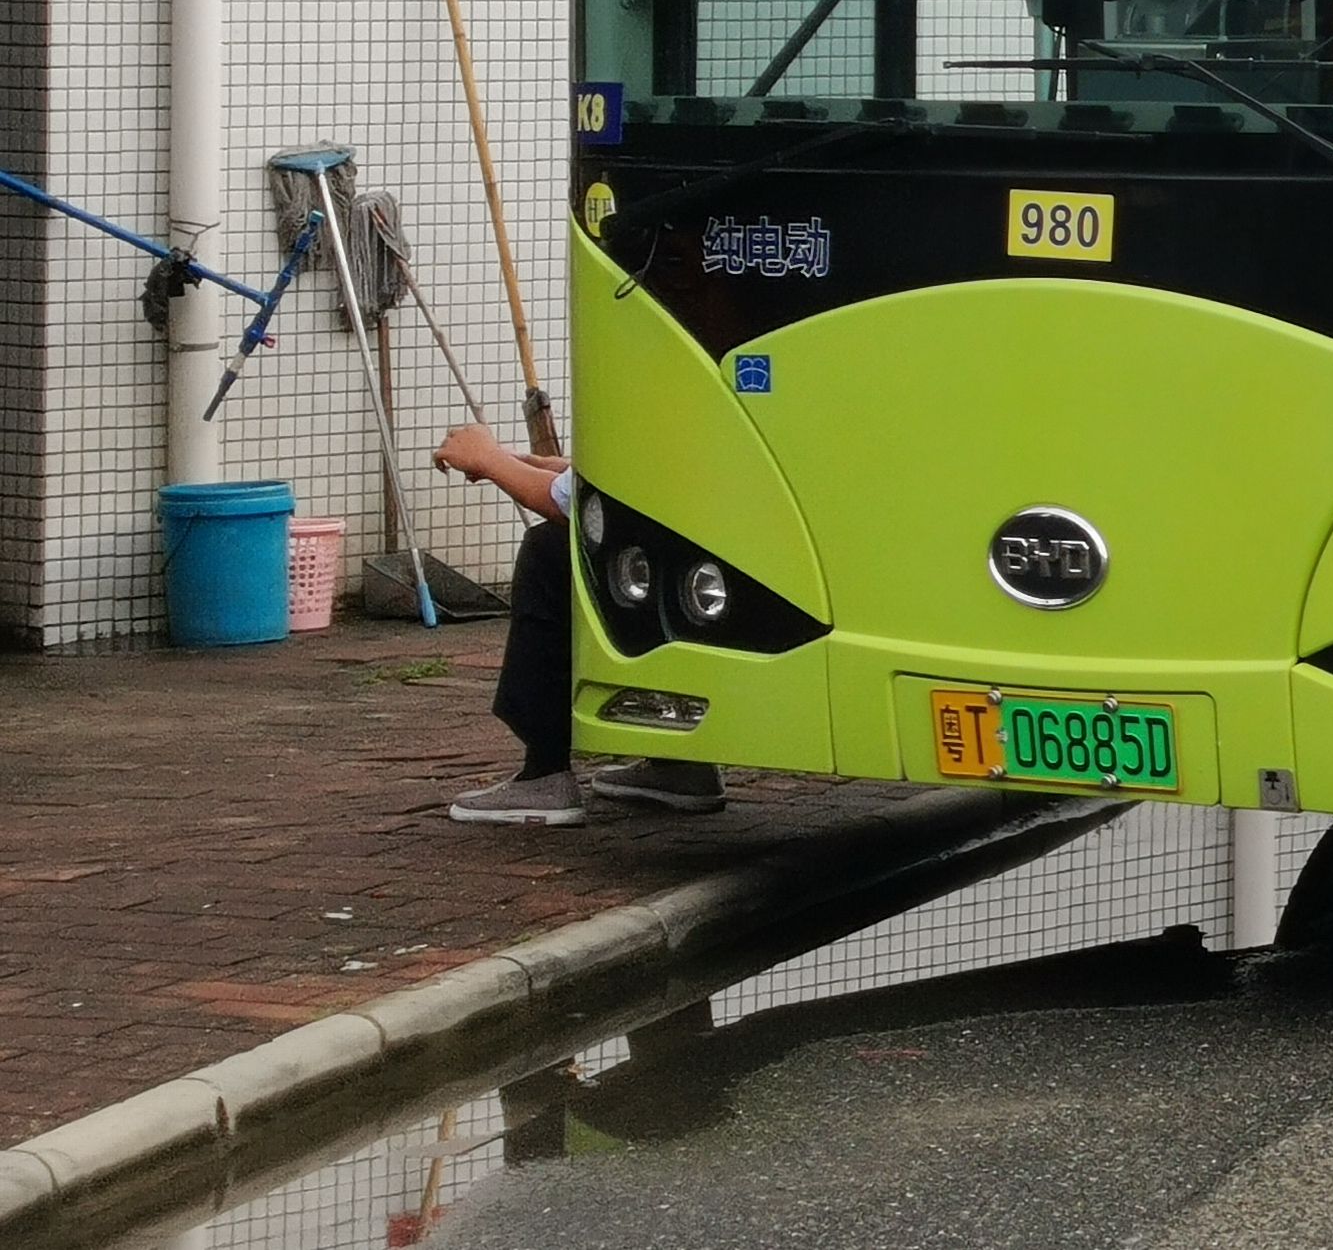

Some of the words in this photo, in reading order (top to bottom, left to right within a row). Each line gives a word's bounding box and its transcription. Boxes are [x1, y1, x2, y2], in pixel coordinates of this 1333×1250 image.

[577, 94, 606, 132] K8
[702, 216, 831, 278] 纯电动
[1020, 202, 1100, 248] 980
[1001, 536, 1091, 579] BYD
[1011, 708, 1172, 778] 06885D
